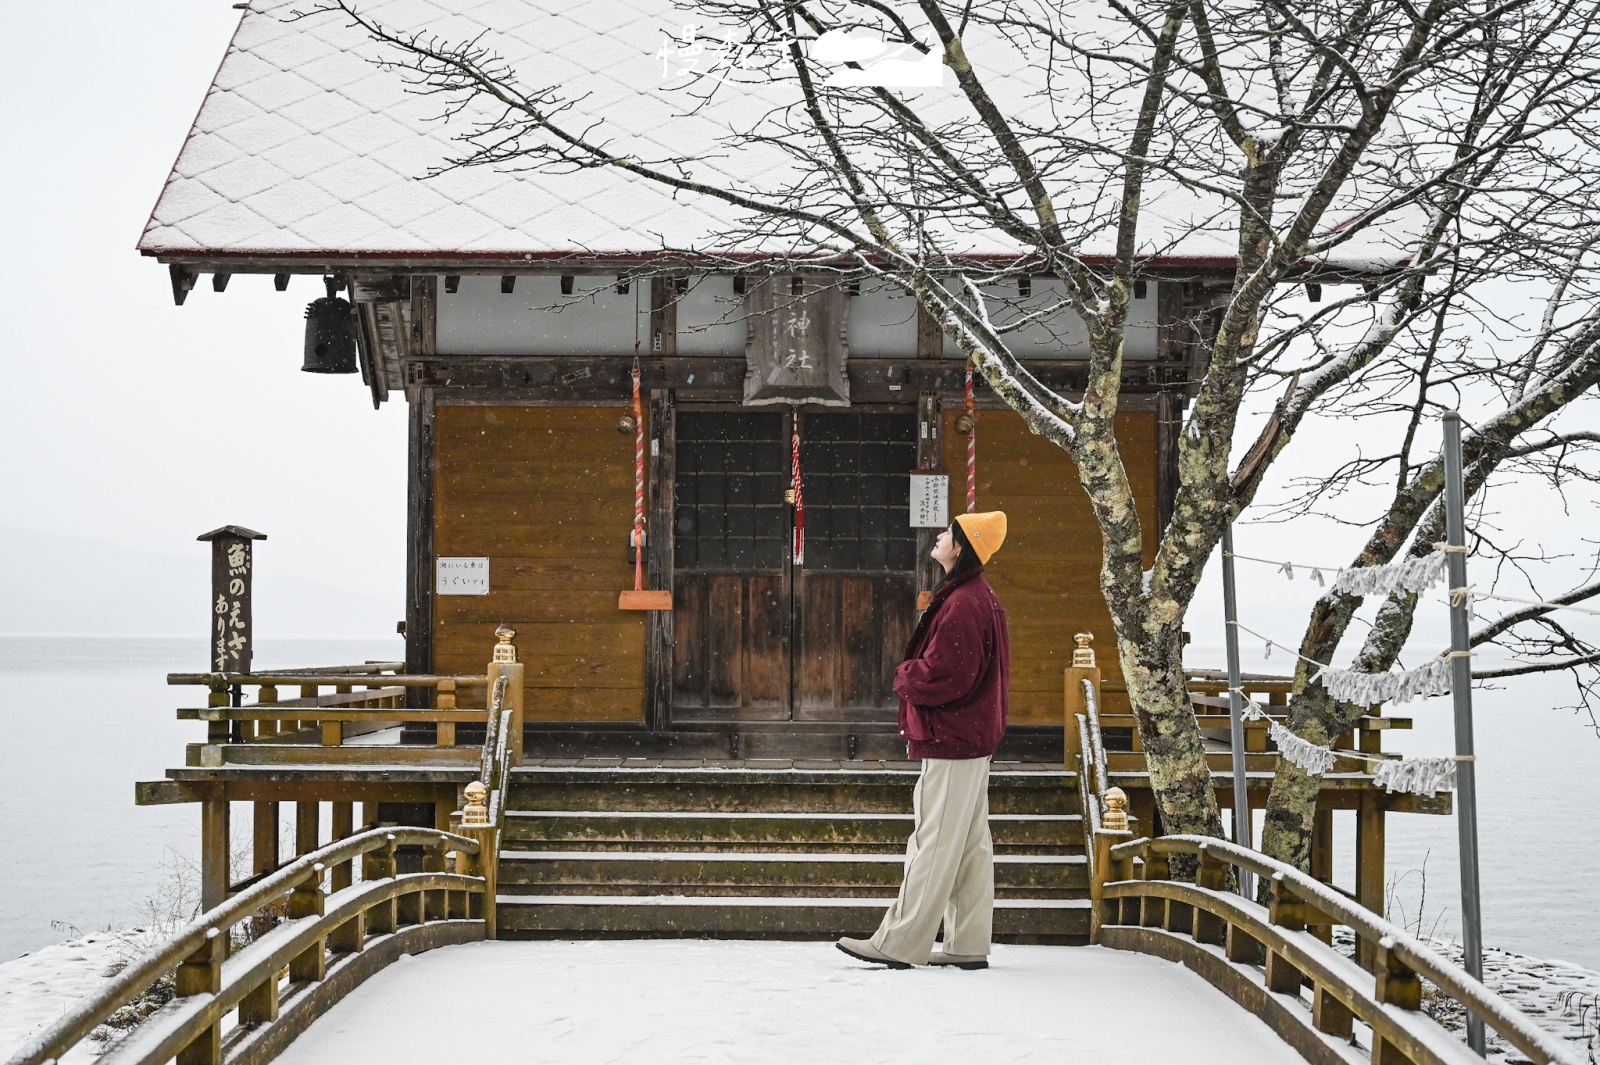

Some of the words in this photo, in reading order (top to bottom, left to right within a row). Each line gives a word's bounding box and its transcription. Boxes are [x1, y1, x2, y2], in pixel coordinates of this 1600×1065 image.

[440, 561, 484, 569] 湖にいる魚は
[442, 576, 485, 586] うぐいです
[227, 543, 247, 660] 魚のえさ
[215, 593, 229, 671] あります
